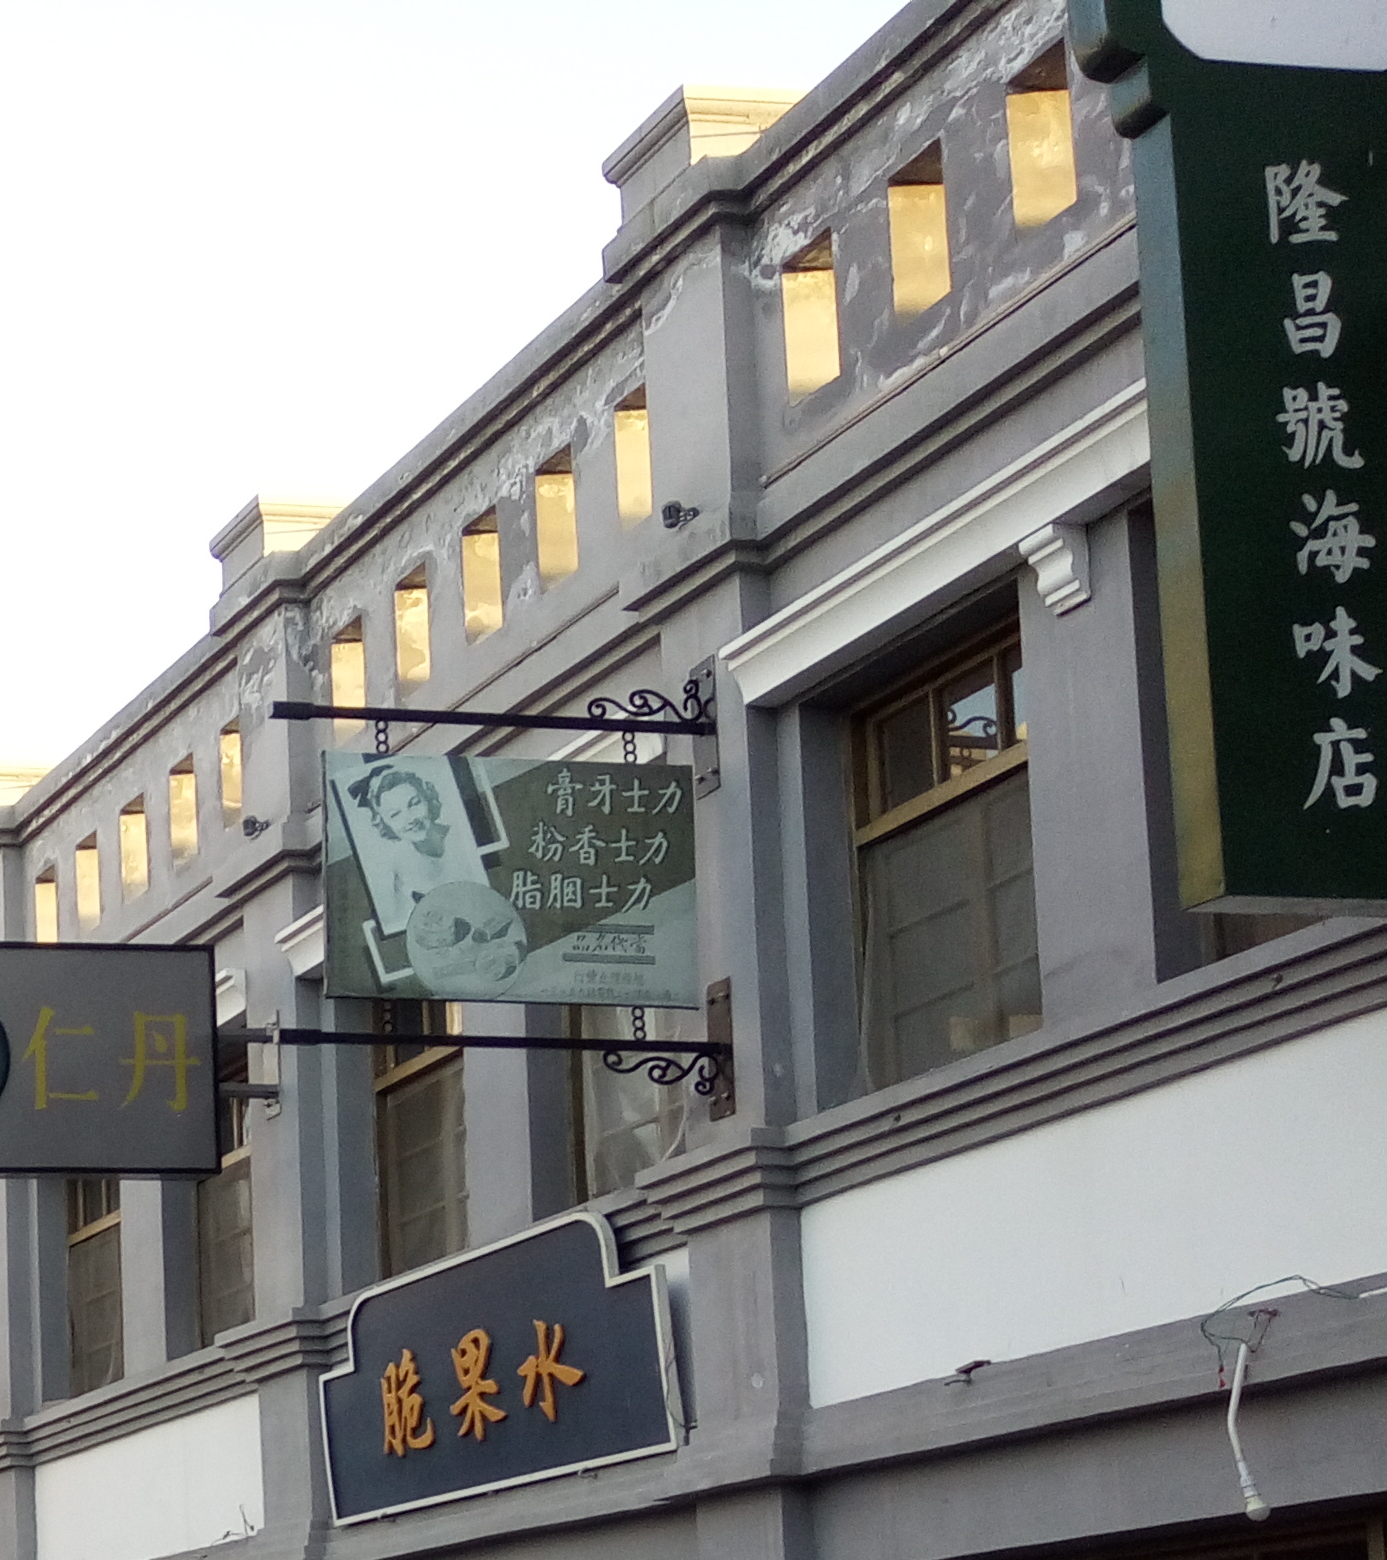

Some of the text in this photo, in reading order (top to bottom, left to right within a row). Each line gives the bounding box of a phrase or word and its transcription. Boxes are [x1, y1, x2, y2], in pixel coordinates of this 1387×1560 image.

[1264, 159, 1384, 811] 隆昌號海味店
[23, 1006, 201, 1113] 仁丹
